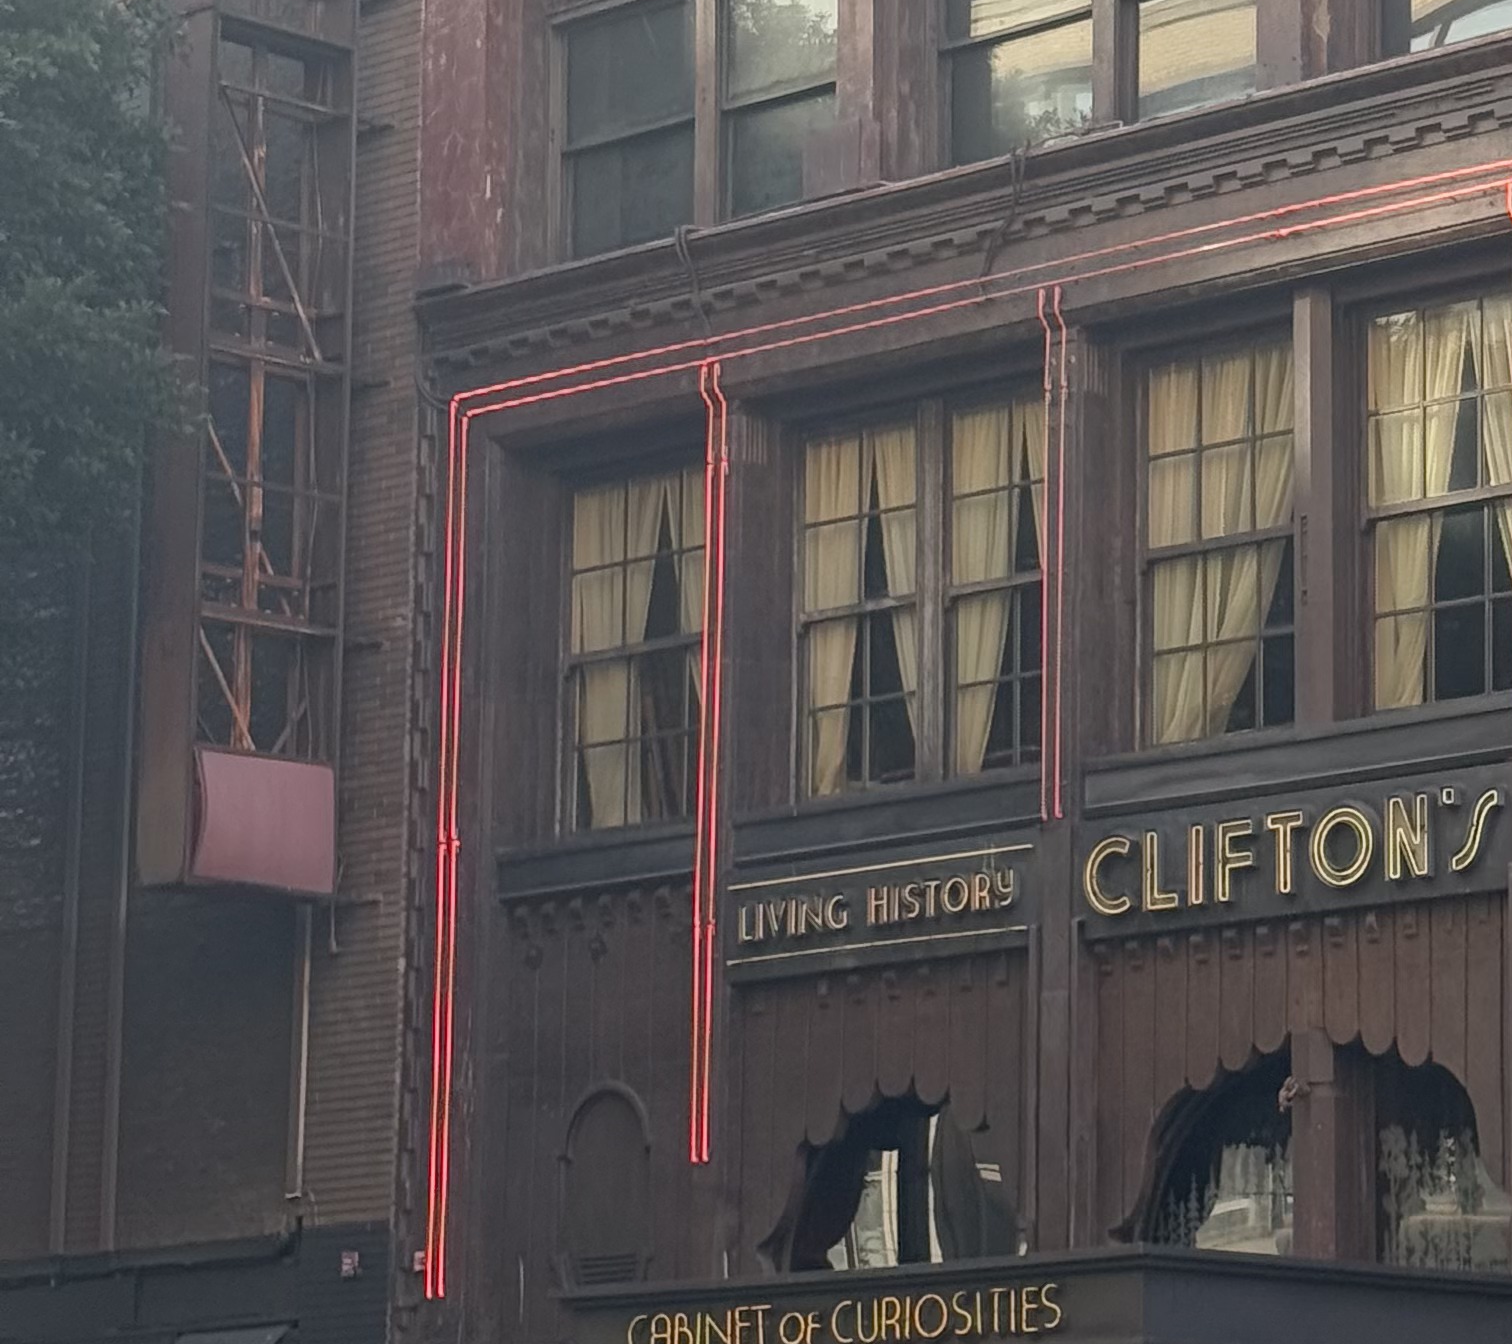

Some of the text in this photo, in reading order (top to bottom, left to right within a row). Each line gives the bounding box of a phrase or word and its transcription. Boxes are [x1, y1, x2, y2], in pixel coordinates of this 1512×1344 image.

[1083, 787, 1501, 916] CLIFTON'S
[738, 868, 1016, 944] LIVING HISTORY
[831, 1283, 1062, 1344] CURIOSITIES
